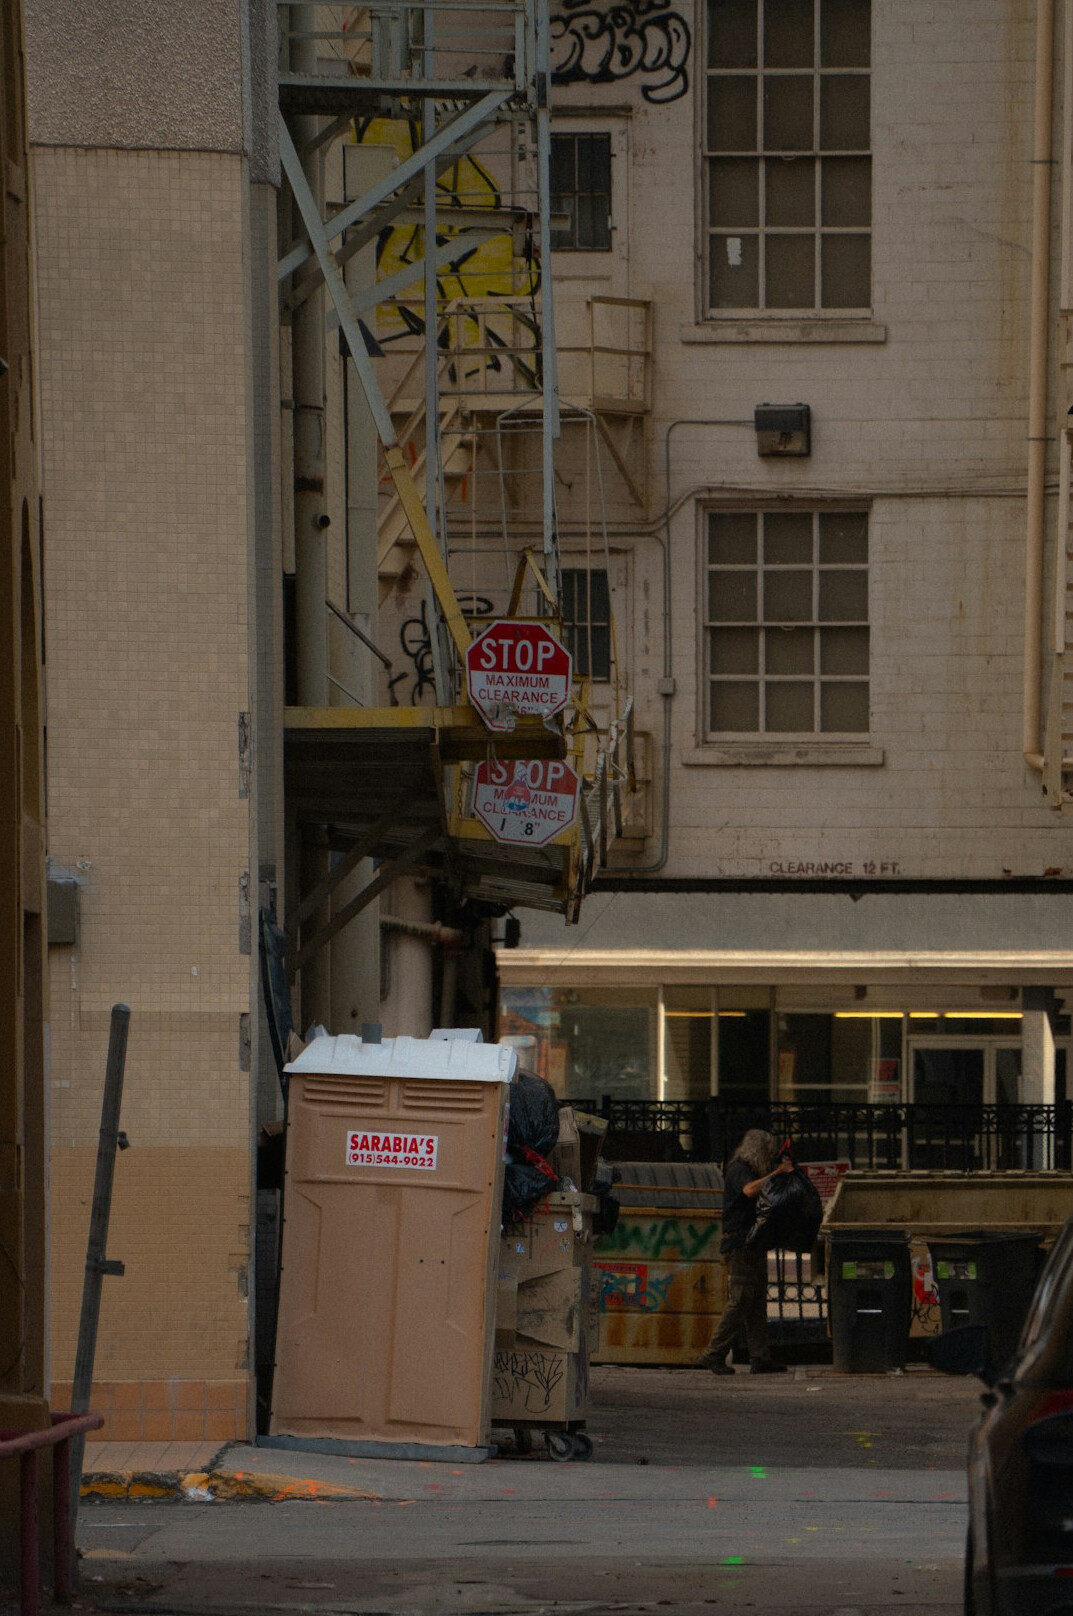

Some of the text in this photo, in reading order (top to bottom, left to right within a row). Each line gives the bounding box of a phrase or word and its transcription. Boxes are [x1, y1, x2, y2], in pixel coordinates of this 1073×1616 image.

[480, 637, 556, 672] STOP
[486, 674, 549, 689] MAXIMUM
[478, 688, 558, 704] CLEARANCE
[493, 788, 558, 807] MMUM
[769, 861, 853, 874] CLEARANCE
[863, 861, 876, 874] 12
[350, 1134, 434, 1155] SARABIA'S
[349, 1153, 434, 1167] (915)544-9022
